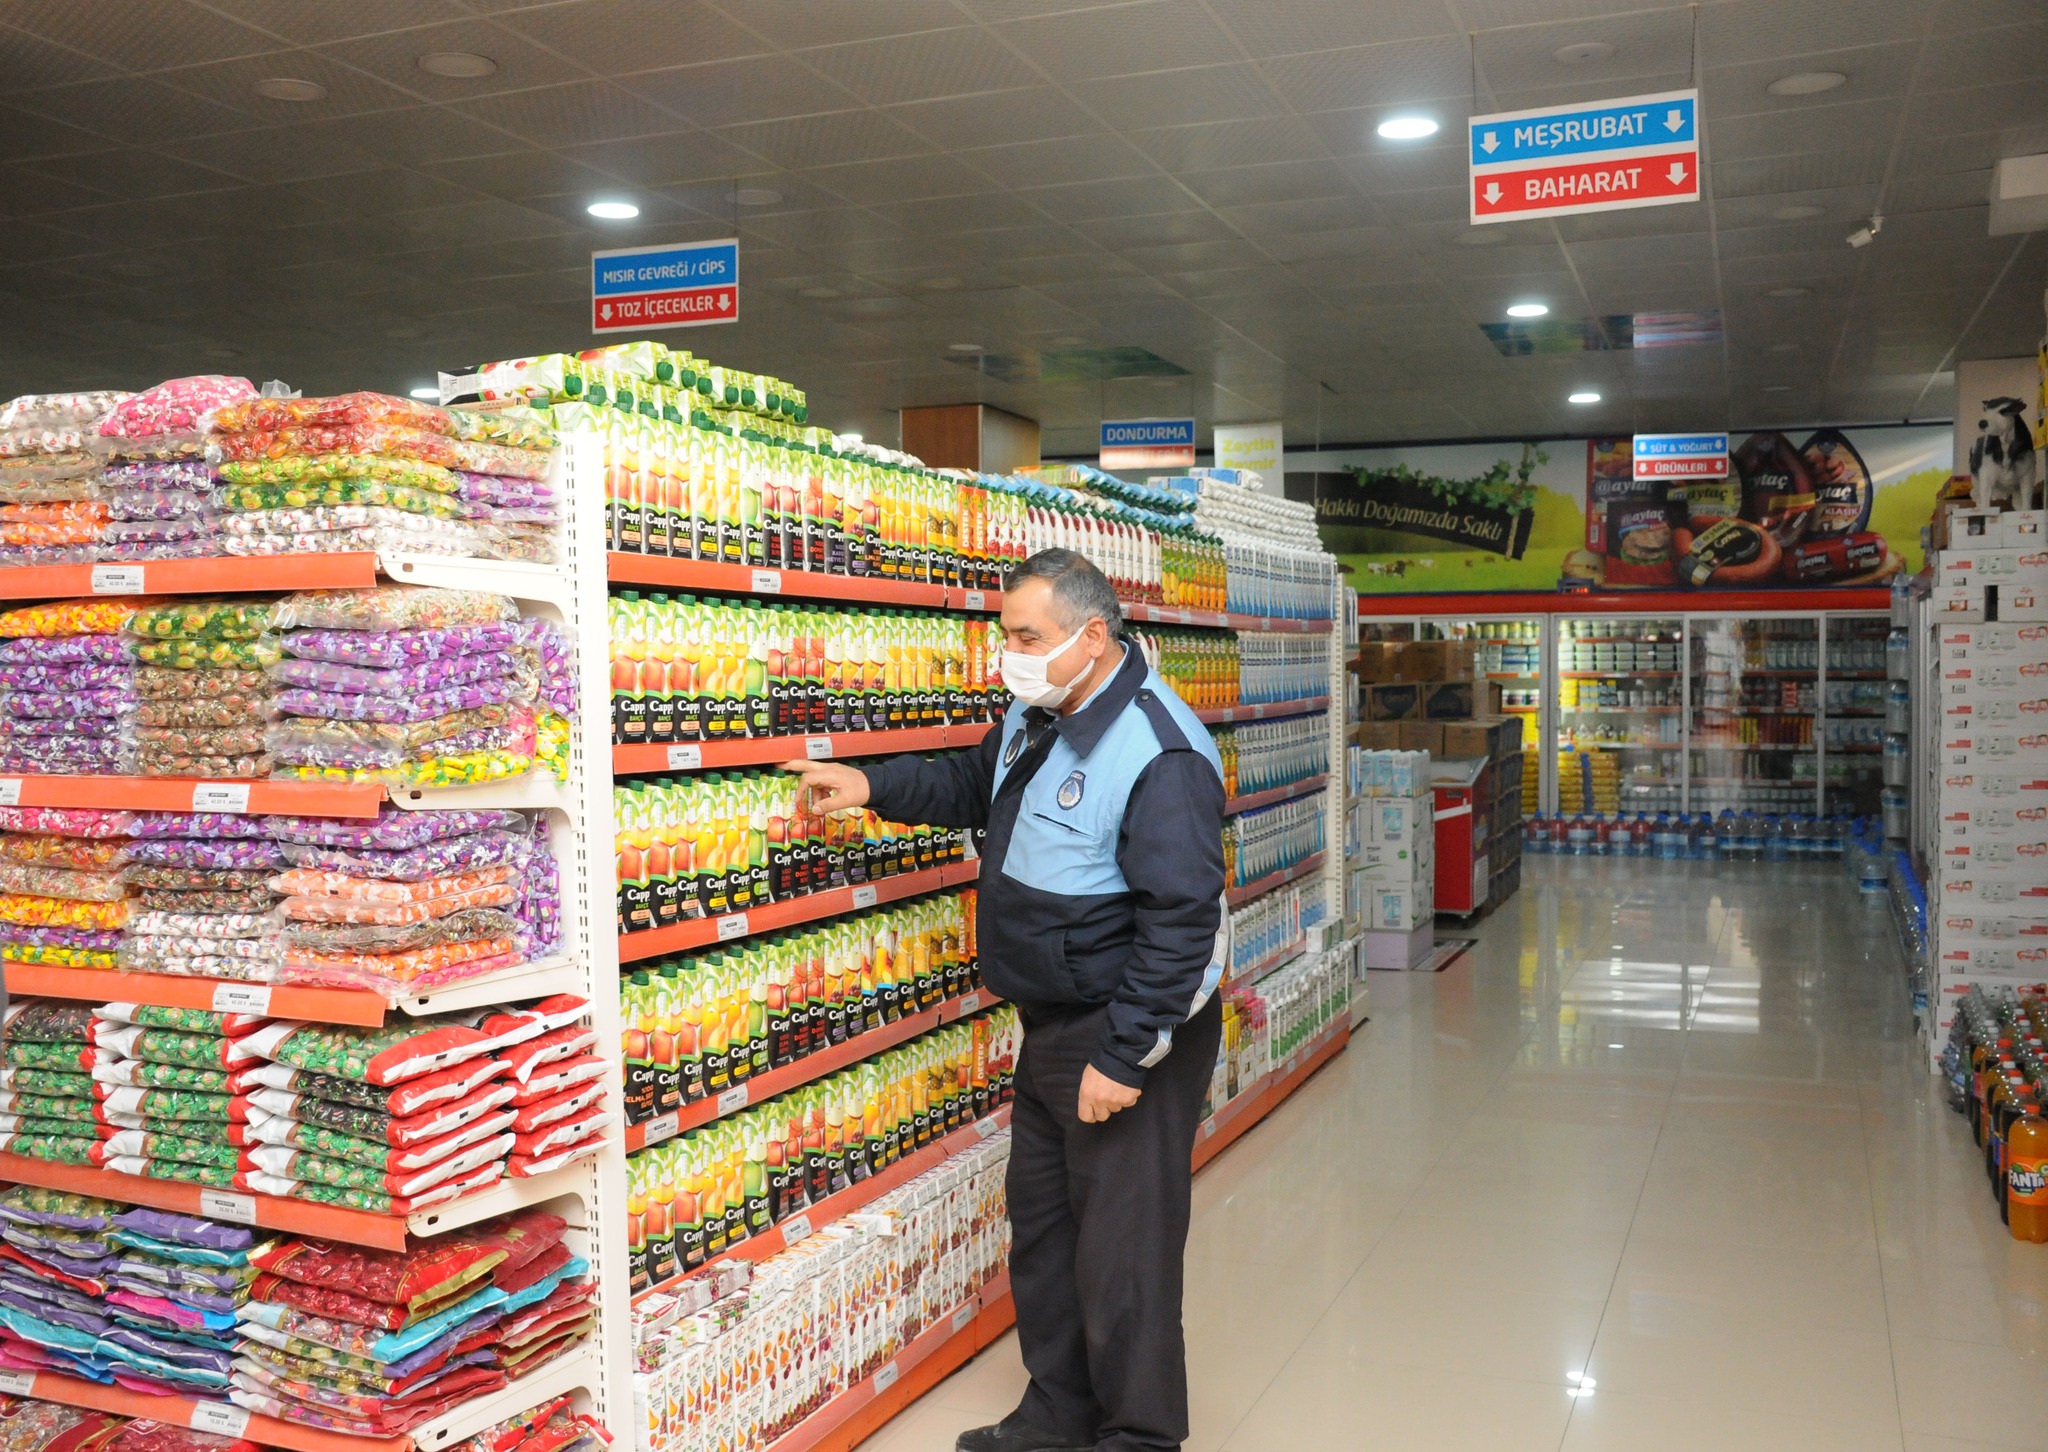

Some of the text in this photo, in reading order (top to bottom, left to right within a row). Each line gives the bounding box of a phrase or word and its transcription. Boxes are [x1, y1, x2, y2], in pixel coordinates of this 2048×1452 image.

[1513, 113, 1648, 149] MEŞRUBAT
[1525, 168, 1642, 201] BAHARAT
[603, 271, 635, 284] MISIR
[638, 261, 689, 281] GEVREĞİ
[698, 259, 726, 275] CİPS
[617, 295, 714, 319] TOZ İÇECEKLER
[1106, 426, 1188, 442] DONDURMA
[1223, 437, 1276, 455] Zeytin
[1650, 443, 1668, 453] SÜT
[1678, 442, 1713, 453] YOĞURT
[1654, 462, 1707, 474] ÜRÜNLERİ
[1816, 485, 1852, 502] ytaç
[618, 508, 640, 525] Capp
[644, 512, 667, 529] Capp
[1314, 497, 1502, 541] Hakkı Doğamızda Saklı
[670, 516, 691, 532] Capp
[697, 521, 717, 539] Capp
[764, 519, 780, 534] Capp
[785, 522, 802, 536] Capp
[721, 524, 740, 540] Capp
[746, 528, 763, 542] Capp
[808, 525, 824, 538] Capp
[826, 528, 844, 542] Capp
[866, 534, 881, 547] Capp
[848, 542, 865, 555] Capp
[880, 546, 896, 559] Capp
[912, 550, 927, 562] Capp
[772, 687, 788, 700] Capp
[790, 686, 806, 700] Capp
[808, 686, 824, 699] Capp
[751, 698, 769, 712] Capp
[827, 696, 845, 709] Capp
[848, 696, 865, 709] Capp
[870, 696, 886, 708] Capp
[887, 695, 902, 707] Capp
[903, 694, 918, 706] Capp
[620, 700, 646, 715] Capp
[650, 700, 673, 715] Capp
[677, 700, 700, 714] Capp
[706, 700, 726, 714] Capp
[726, 700, 746, 714] Capp
[948, 832, 964, 842] Capp
[810, 846, 826, 858] Capp
[867, 846, 882, 858] Capp
[882, 844, 898, 854] Capp
[898, 840, 915, 851] Capp
[774, 854, 792, 866] Capp
[793, 850, 809, 862] Capp
[828, 854, 844, 866] Capp
[848, 850, 865, 862] Capp
[730, 874, 750, 886] Capp
[751, 868, 769, 881] Capp
[656, 884, 678, 898] Capp
[678, 880, 698, 893] Capp
[706, 878, 727, 891] Capp
[627, 889, 650, 903] Capp
[846, 1004, 863, 1014] Capp
[863, 997, 878, 1008] Capp
[792, 1012, 809, 1024] Capp
[810, 1006, 826, 1018] Capp
[828, 1010, 846, 1020] Capp
[772, 1020, 790, 1032] Capp
[750, 1039, 768, 1050] Capp
[731, 1047, 750, 1059] Capp
[708, 1056, 729, 1068] Capp
[684, 1064, 703, 1075] Capp
[632, 1070, 654, 1083] Capp
[658, 1072, 680, 1085] Capp
[900, 1124, 914, 1134] Capp
[850, 1149, 866, 1161] Capp
[810, 1156, 826, 1168] Capp
[829, 1158, 845, 1170] Capp
[788, 1166, 804, 1178] Capp
[2008, 1169, 2046, 1188] FANTA
[773, 1175, 790, 1188] Capp
[750, 1196, 770, 1210] Capp
[726, 1207, 746, 1220] Capp
[706, 1219, 726, 1232] Capp
[684, 1230, 704, 1243] Capp
[653, 1241, 674, 1254] Capp
[629, 1253, 647, 1268] Capp
